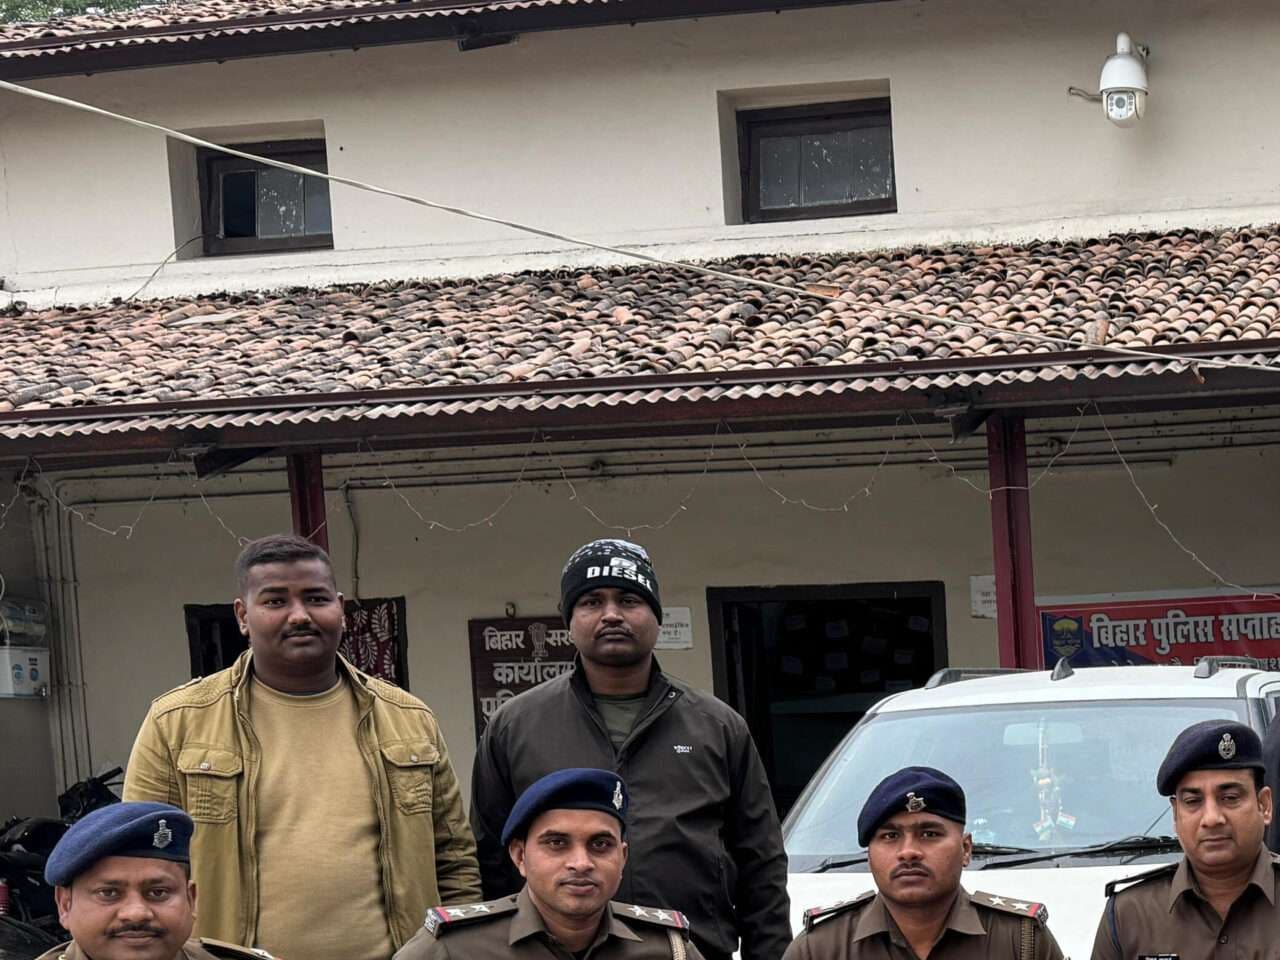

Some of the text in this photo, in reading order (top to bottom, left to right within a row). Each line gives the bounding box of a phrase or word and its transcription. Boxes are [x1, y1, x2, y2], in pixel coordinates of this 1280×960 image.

[586, 565, 654, 592] DIESEL
[483, 626, 526, 651] बिहार
[1089, 612, 1148, 649] बिहार
[1150, 608, 1216, 655] पुलिस
